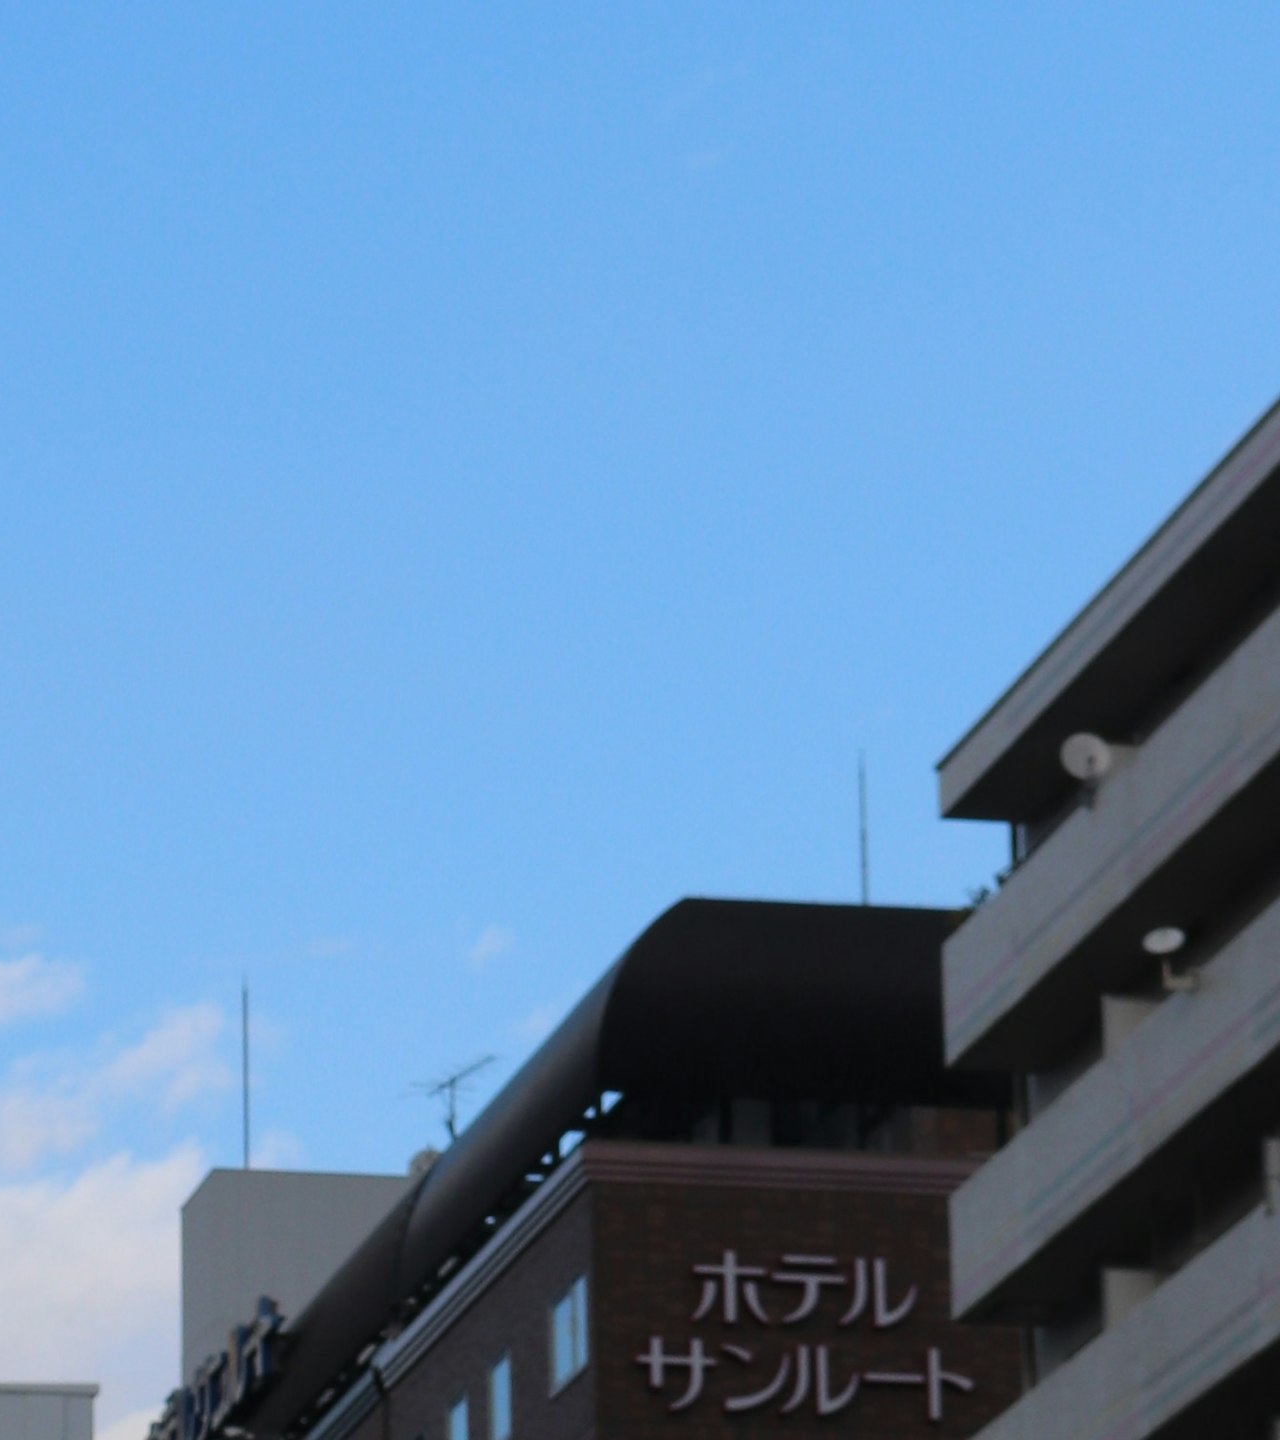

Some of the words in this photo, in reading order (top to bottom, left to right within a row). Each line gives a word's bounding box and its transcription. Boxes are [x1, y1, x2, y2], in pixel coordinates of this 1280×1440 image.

[691, 1248, 920, 1328] ホテル
[637, 1337, 975, 1423] サンルート
